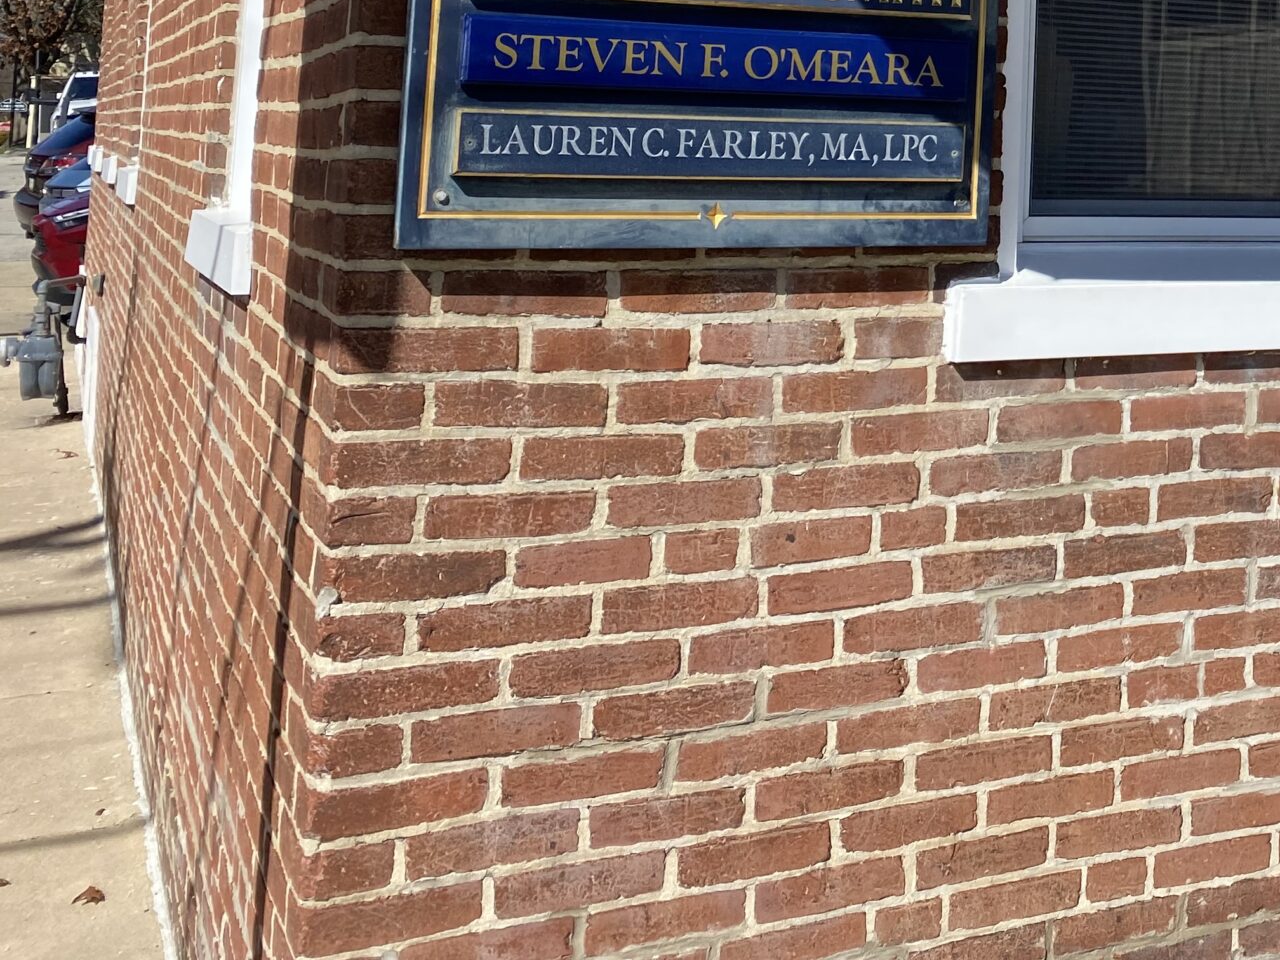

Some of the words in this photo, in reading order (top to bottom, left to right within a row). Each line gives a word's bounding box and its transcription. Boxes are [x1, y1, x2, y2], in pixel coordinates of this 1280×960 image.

[493, 32, 688, 76] STEVEN
[700, 43, 729, 78] F.
[744, 45, 944, 87] O'MEARA
[480, 123, 636, 157] LAUREN
[641, 127, 670, 157] C.
[882, 134, 938, 162] LPC
